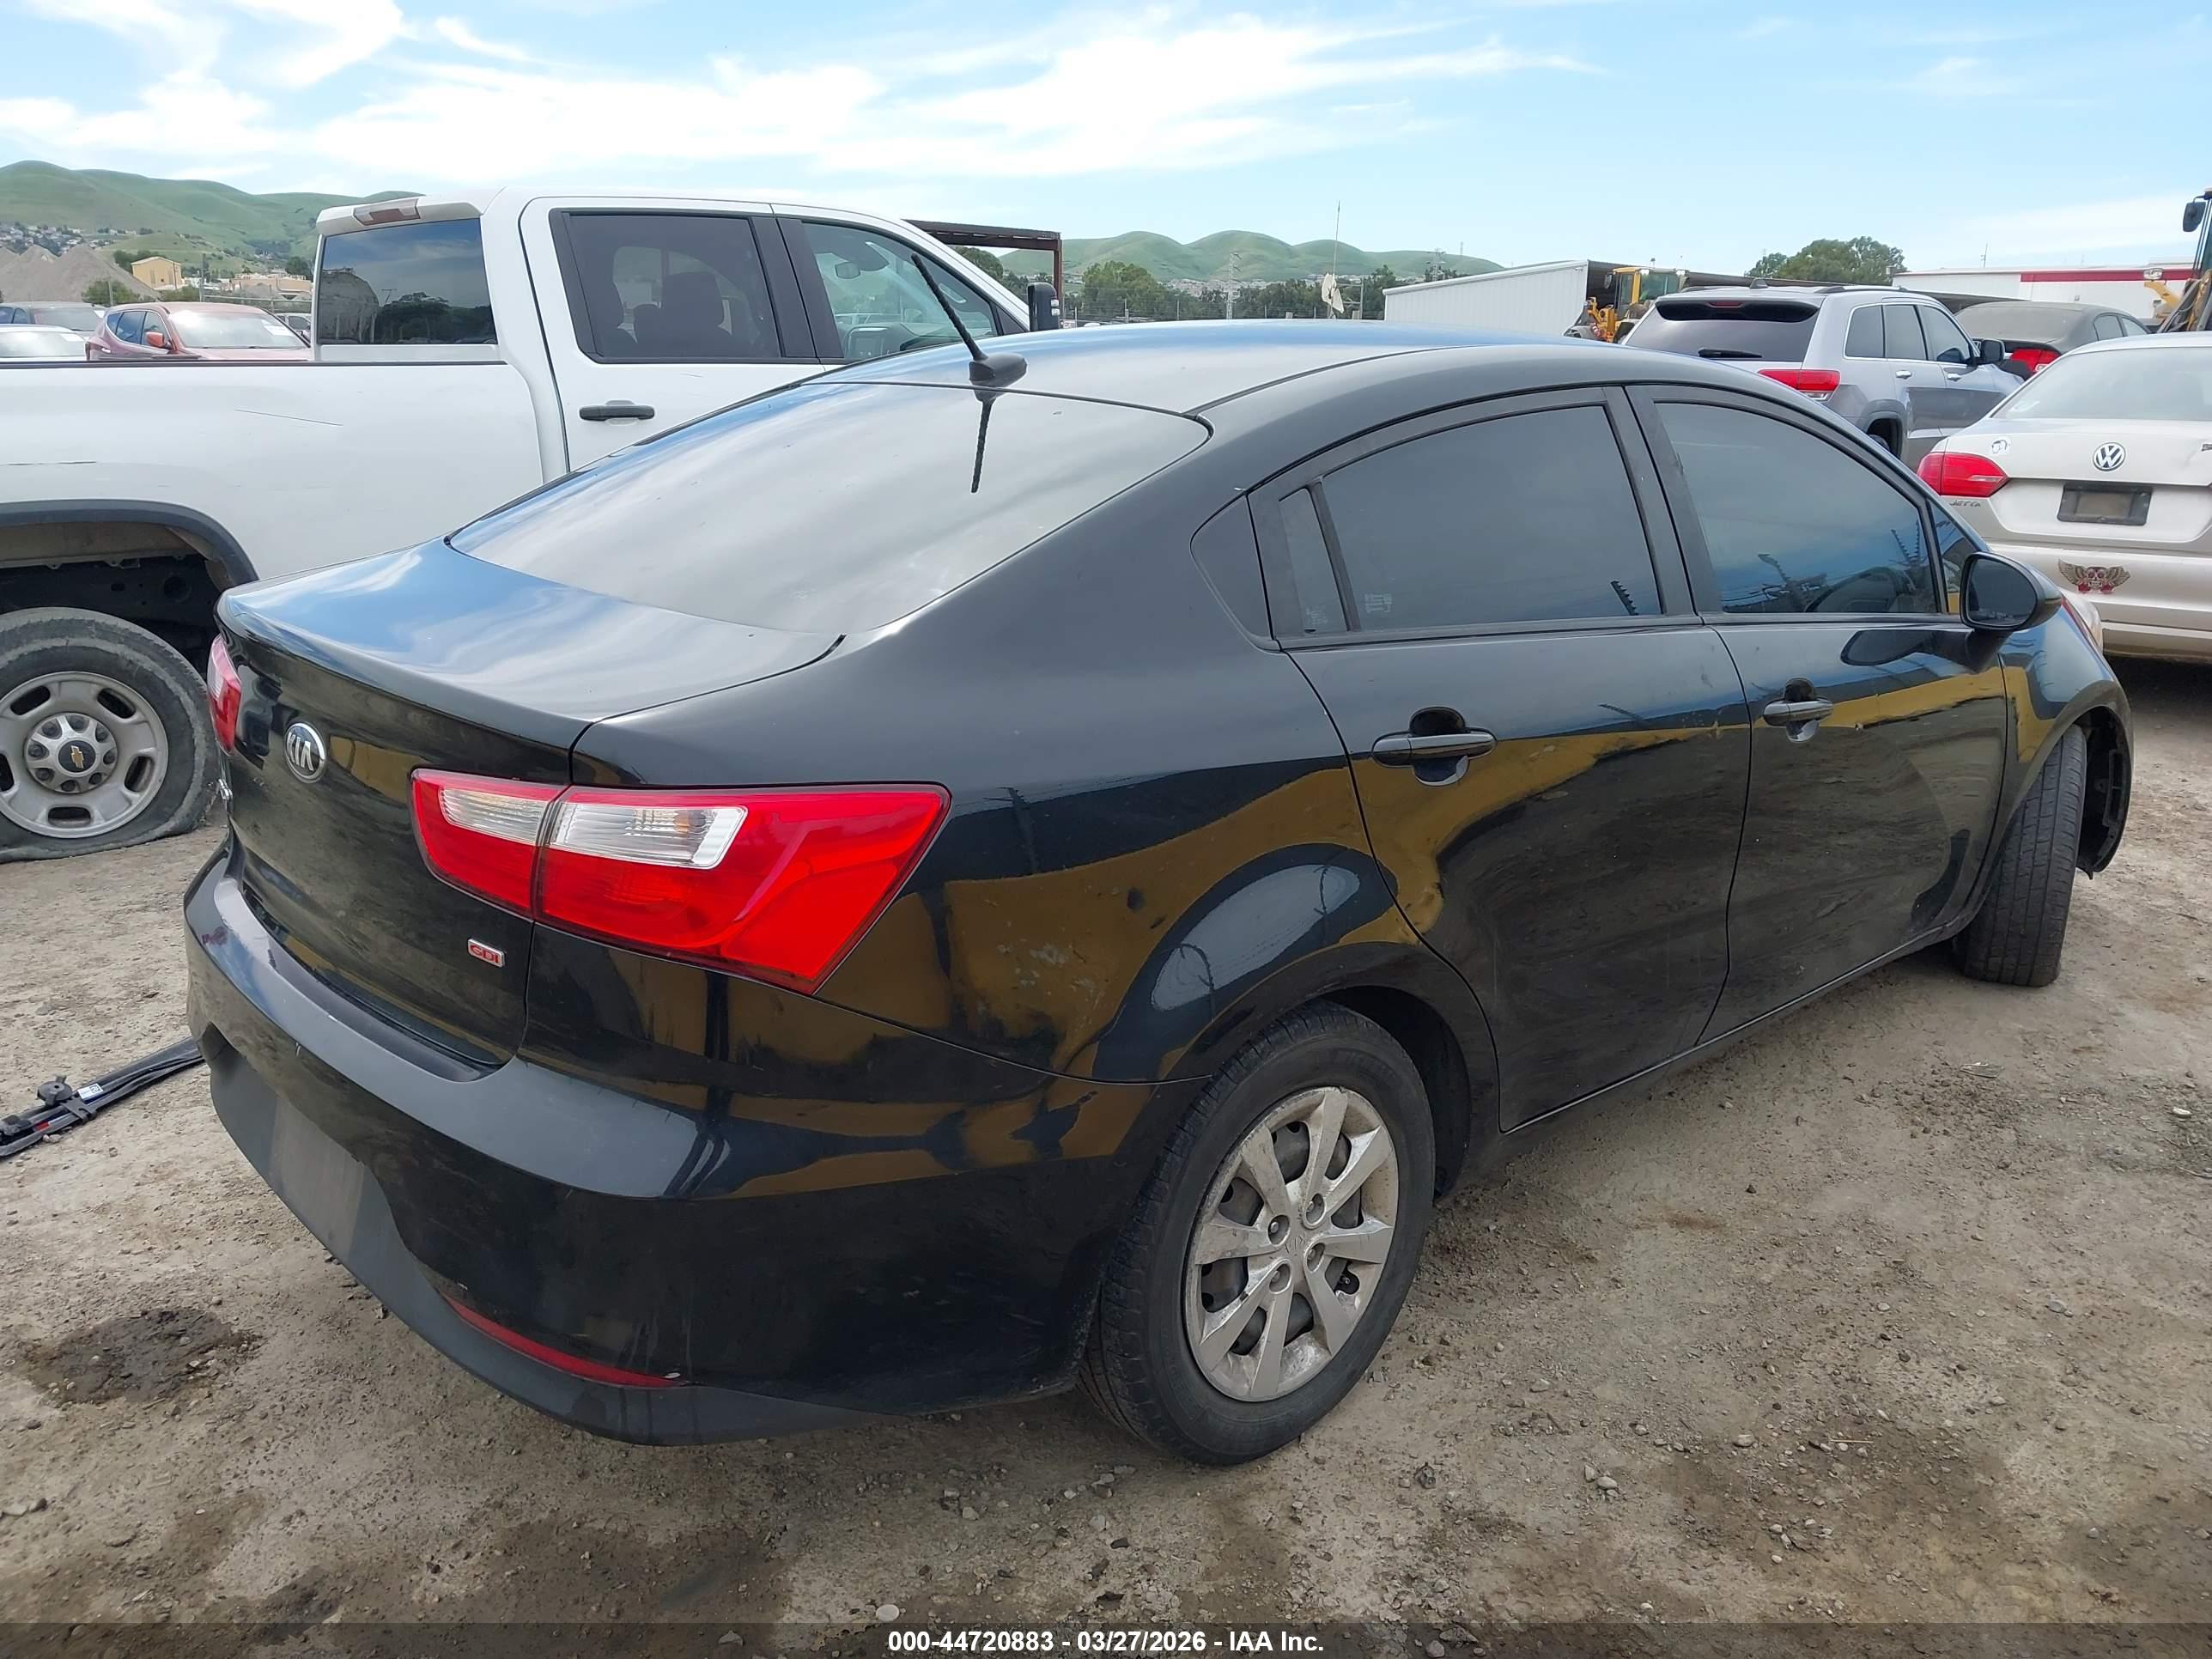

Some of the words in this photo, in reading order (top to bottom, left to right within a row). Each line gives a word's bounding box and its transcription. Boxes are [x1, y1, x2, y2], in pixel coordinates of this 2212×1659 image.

[2094, 443, 2125, 470] VW
[1948, 499, 1981, 507] JETTA
[287, 730, 315, 772] KIA
[470, 944, 499, 963] GDI
